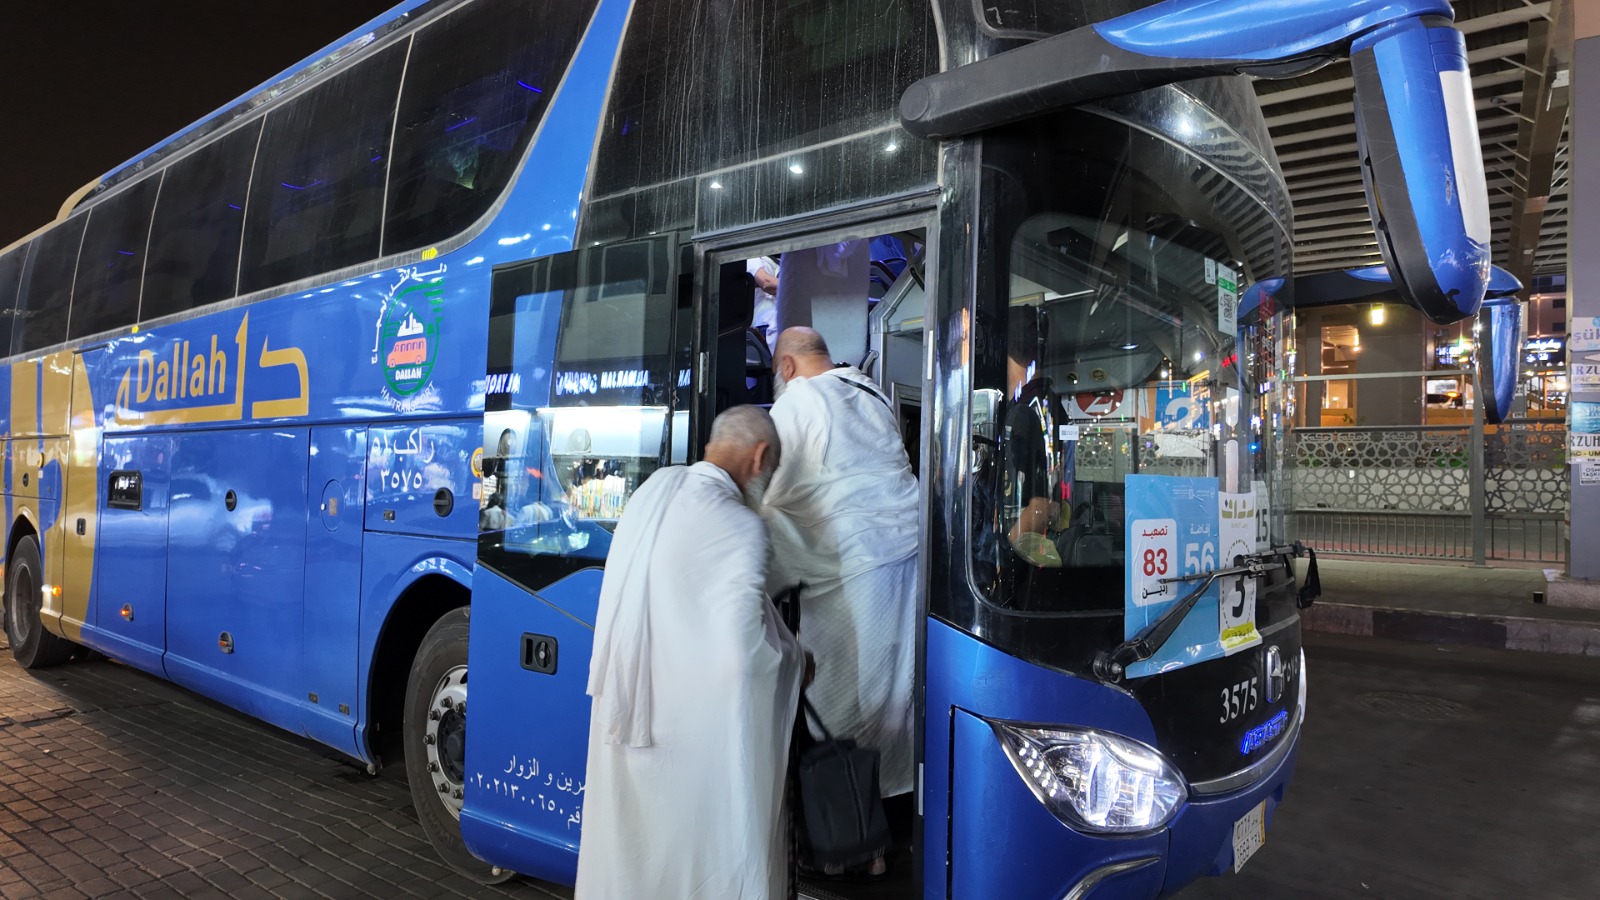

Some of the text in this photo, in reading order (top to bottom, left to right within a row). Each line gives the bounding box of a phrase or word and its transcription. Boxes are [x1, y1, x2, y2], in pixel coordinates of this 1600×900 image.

[136, 335, 227, 403] Dallah
[395, 368, 422, 380] DALLAH
[393, 428, 434, 464] راكب
[380, 468, 423, 493] ٣٥٧٥
[1142, 526, 1168, 540] تصعيد
[1189, 523, 1211, 538] إفاضة
[1255, 508, 1269, 543] 15
[1143, 548, 1168, 576] 83
[1184, 541, 1215, 584] 56
[1219, 676, 1258, 724] 3575
[504, 755, 539, 780] الزوار
[544, 773, 553, 786] و
